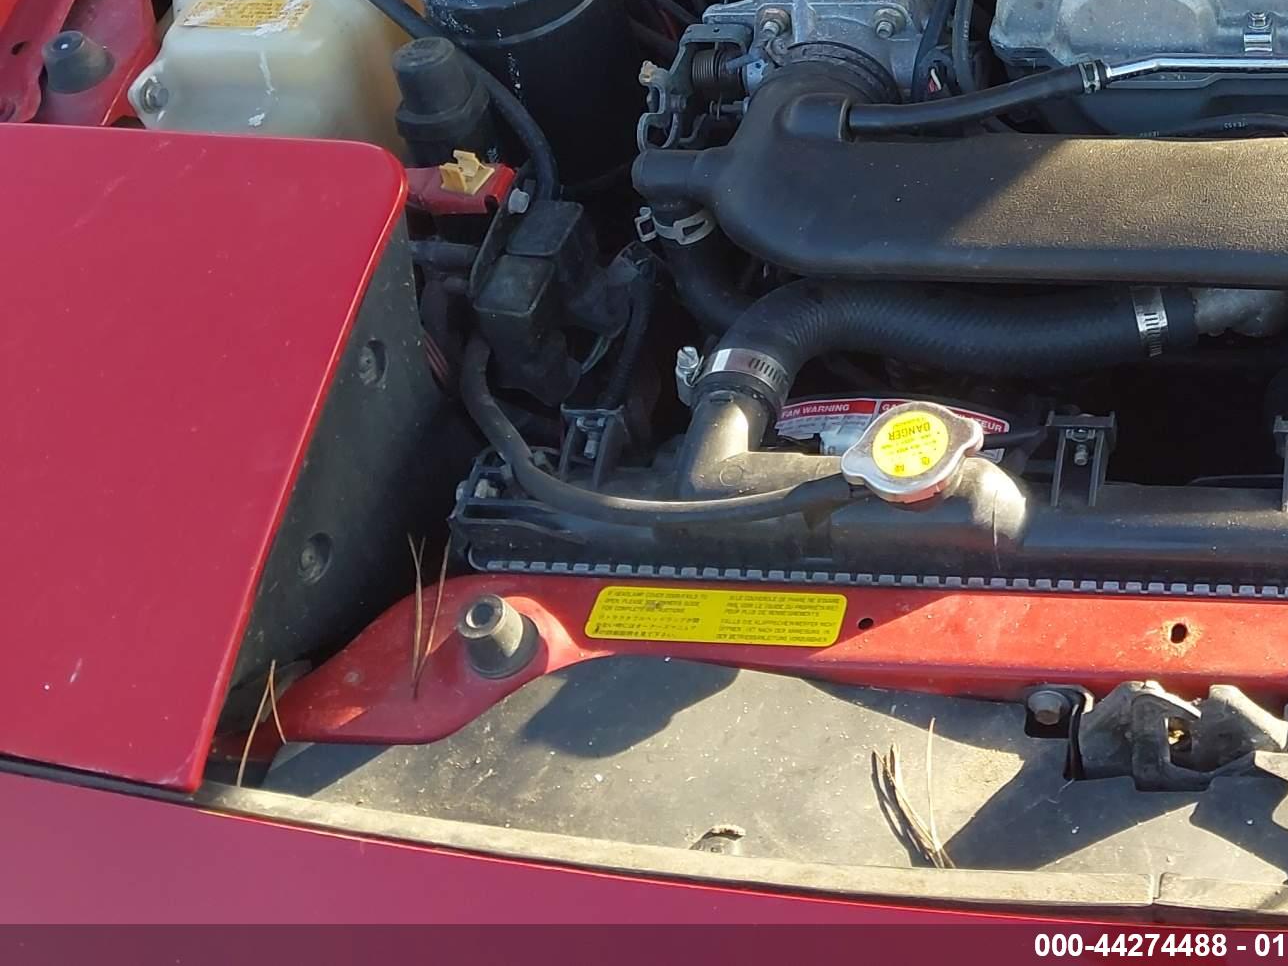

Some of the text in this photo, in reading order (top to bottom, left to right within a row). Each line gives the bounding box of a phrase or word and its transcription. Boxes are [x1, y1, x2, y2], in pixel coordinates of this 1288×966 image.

[782, 403, 850, 419] FAN WARNING
[888, 421, 931, 441] DANGER
